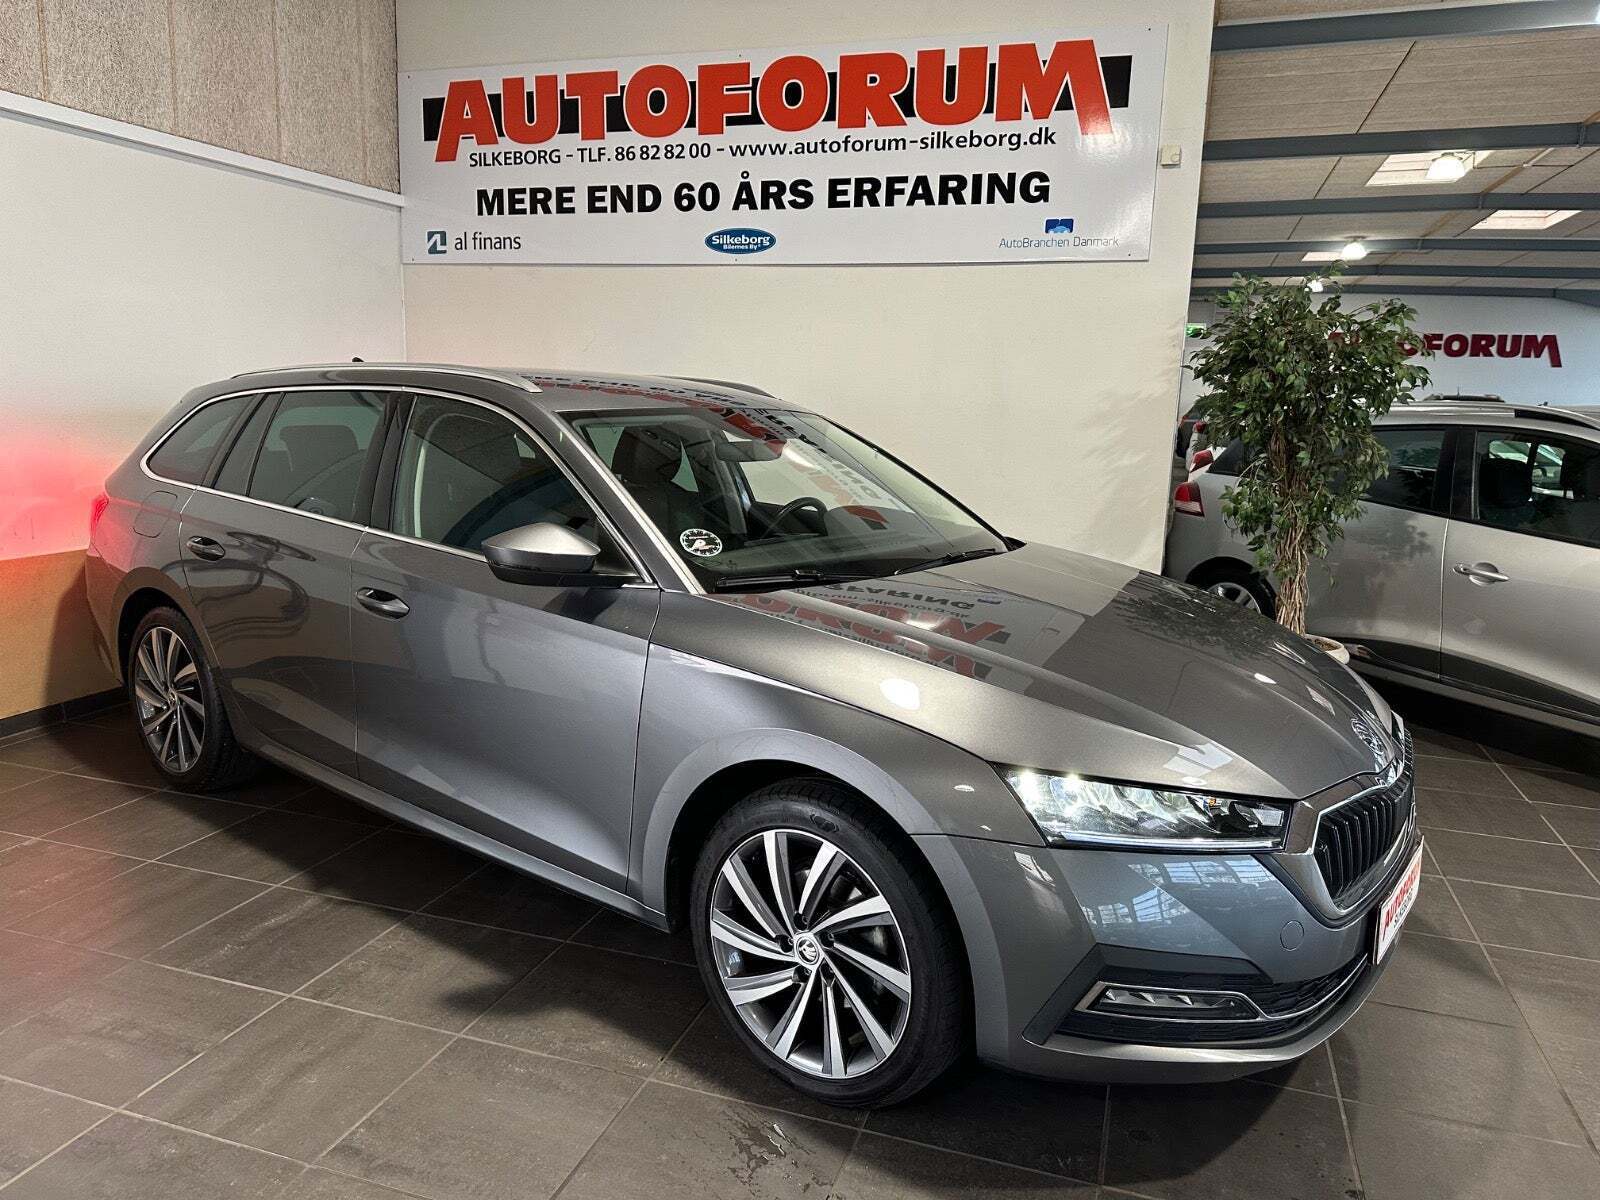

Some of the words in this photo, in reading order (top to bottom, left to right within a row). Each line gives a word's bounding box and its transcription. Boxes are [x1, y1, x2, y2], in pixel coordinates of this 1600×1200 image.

[434, 39, 1112, 162] AUTOFORUM
[469, 148, 561, 167] SILKEBORG
[577, 147, 611, 163] TLF.
[615, 145, 636, 162] 86
[639, 144, 660, 161] 82
[664, 143, 685, 160] 82
[689, 142, 711, 159] 00
[729, 127, 1056, 157] www.autoforum-silkeborg.dk
[476, 186, 576, 216] MERE
[587, 184, 662, 214] END
[673, 181, 720, 212] 60
[732, 170, 814, 211] ÅRS
[827, 171, 1050, 209] ERFARING
[454, 233, 468, 251] al
[472, 232, 521, 250] finans
[711, 234, 770, 246] Silkeborg
[999, 237, 1070, 249] AutoBranchen
[1072, 236, 1119, 248] Danmark
